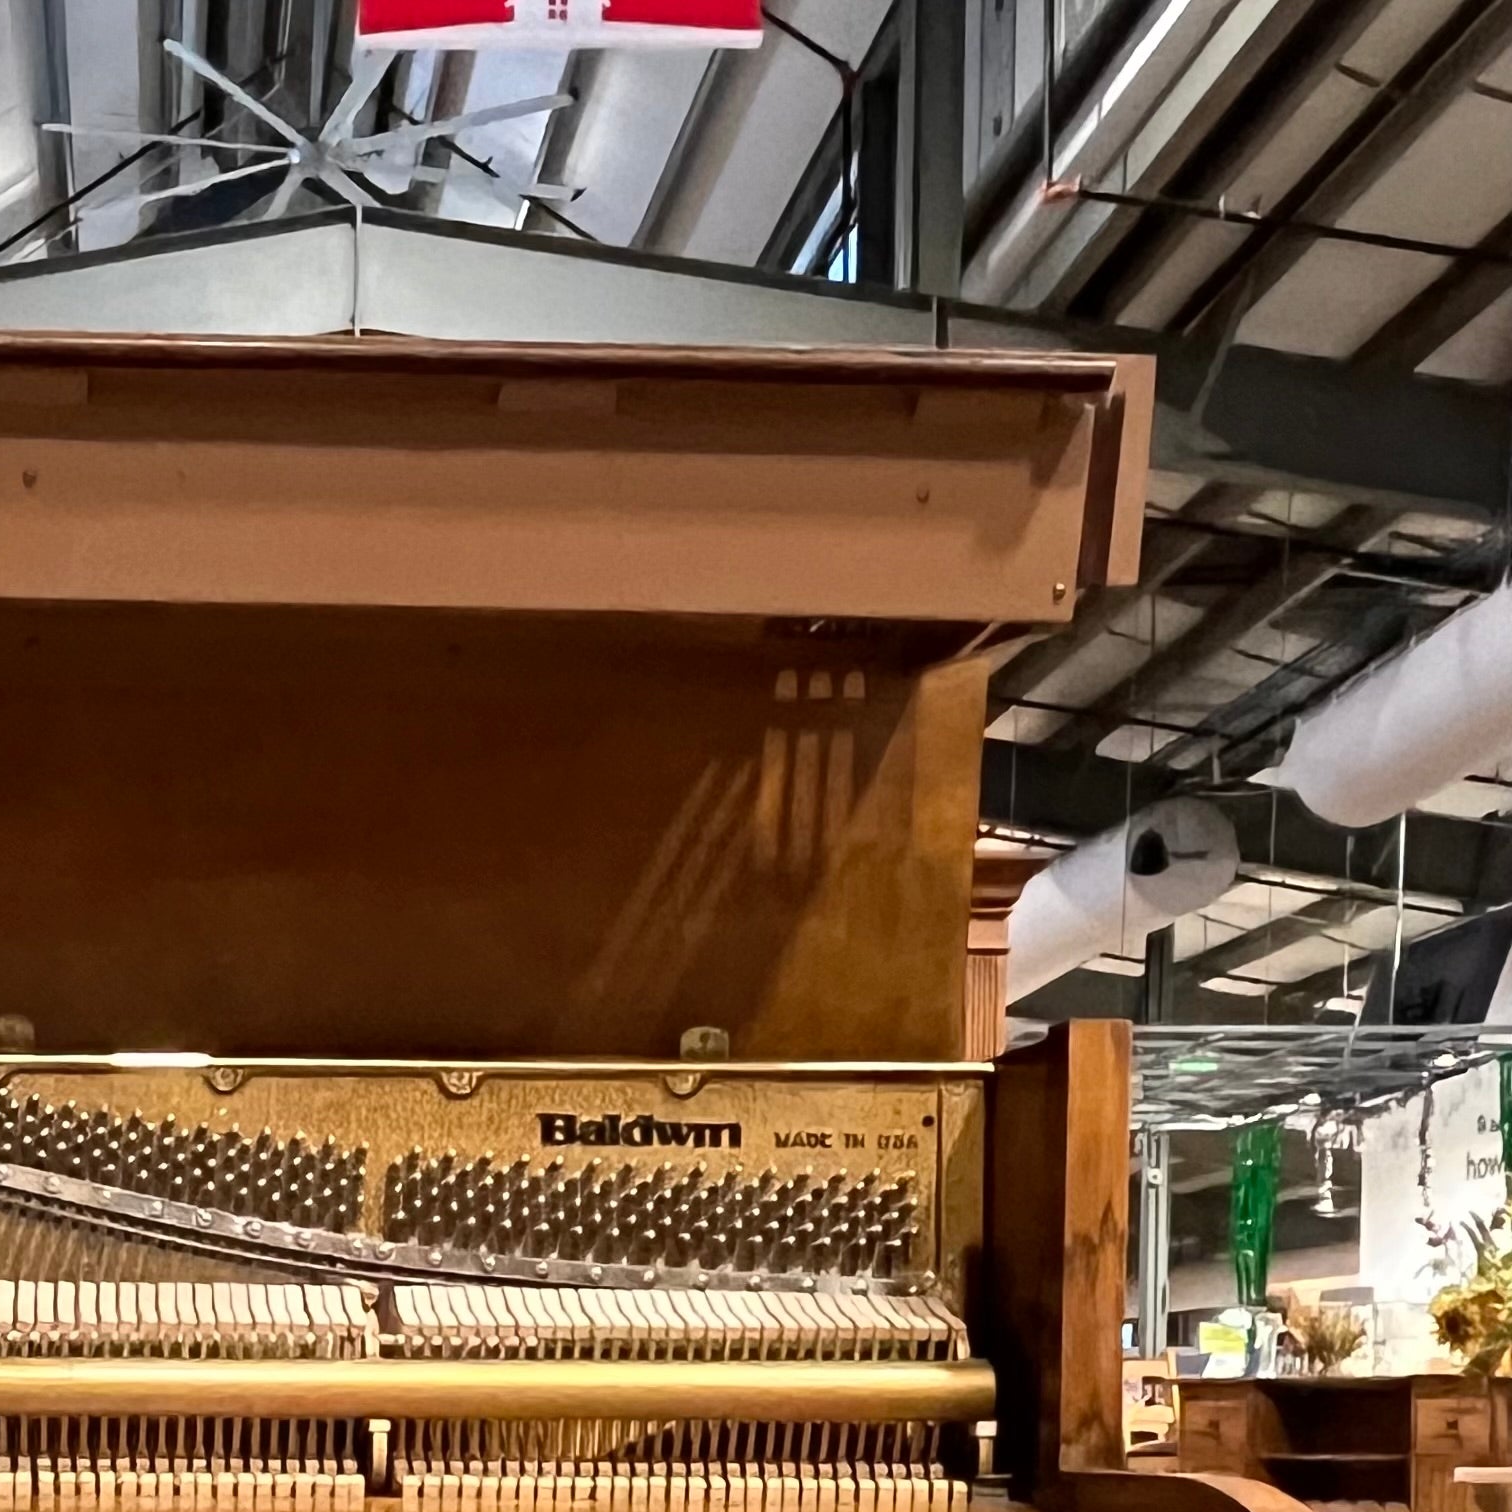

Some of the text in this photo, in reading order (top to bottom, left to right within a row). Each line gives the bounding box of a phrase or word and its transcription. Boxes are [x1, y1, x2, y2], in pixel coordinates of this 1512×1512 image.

[536, 1113, 742, 1148] Baldwin
[774, 1131, 832, 1149] MADE
[843, 1132, 865, 1149] IN
